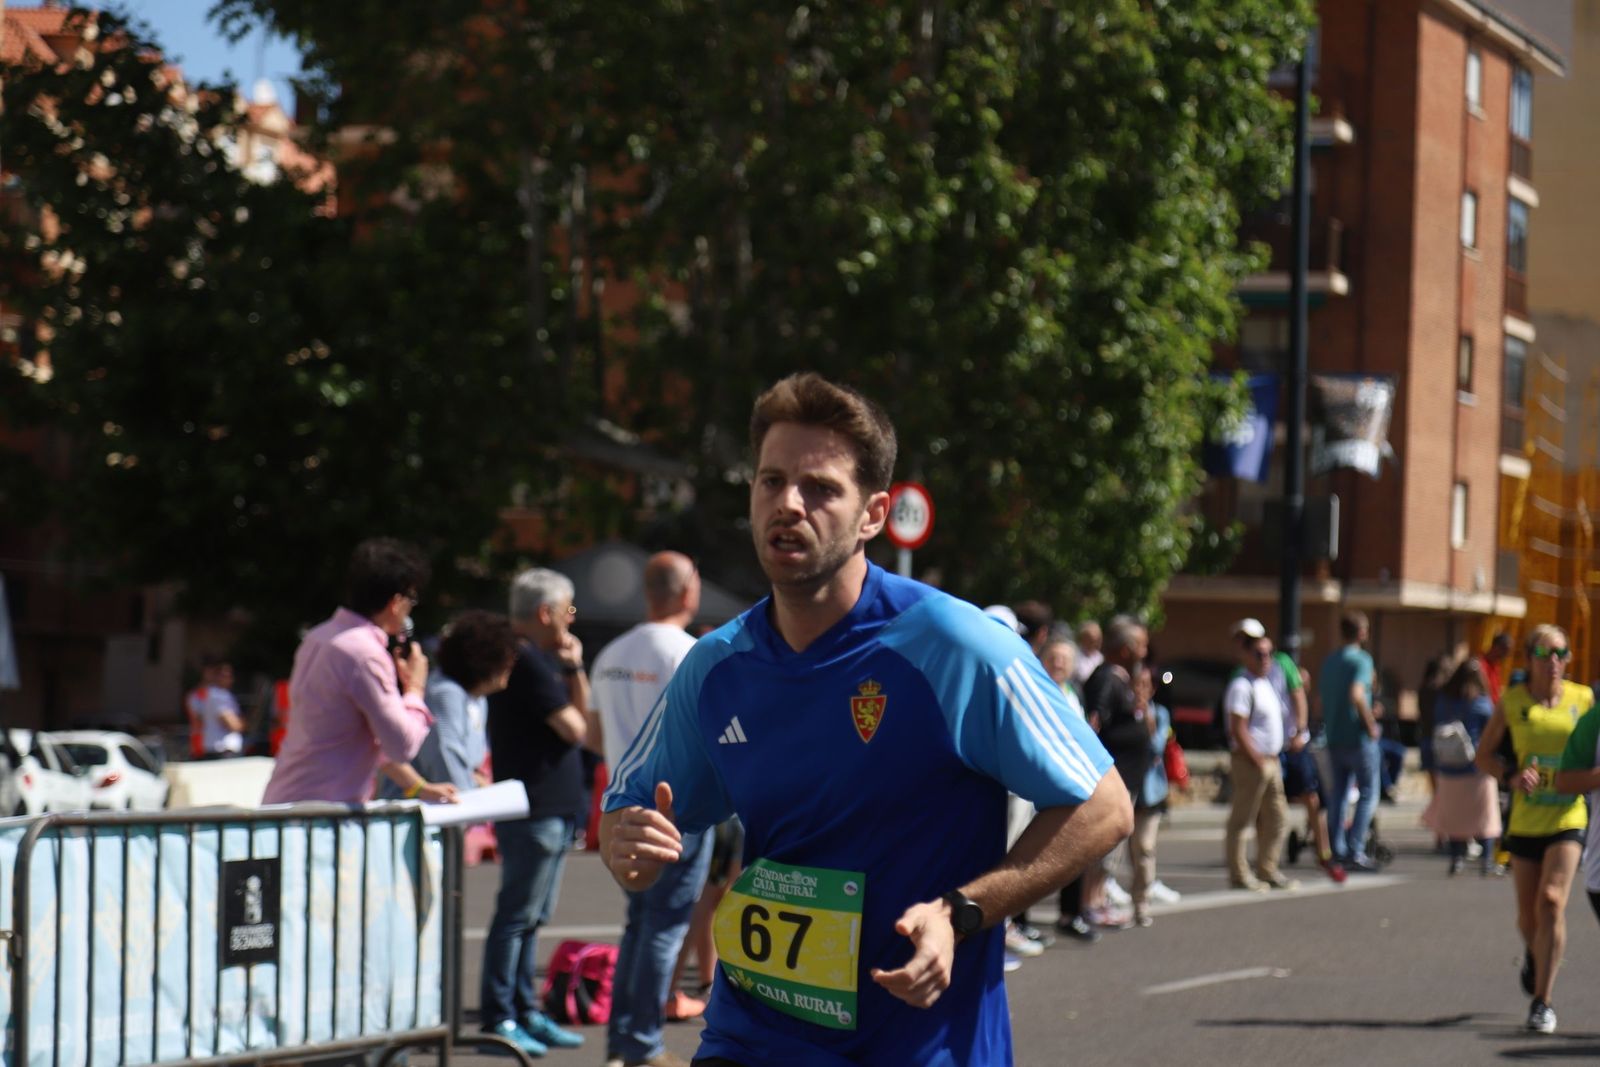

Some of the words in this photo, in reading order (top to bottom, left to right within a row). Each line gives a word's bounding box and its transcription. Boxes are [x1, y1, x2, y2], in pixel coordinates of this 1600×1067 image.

[778, 883, 817, 899] RURAL
[740, 904, 813, 970] 67
[756, 983, 791, 1005] CAJA
[793, 993, 844, 1017] RURAL
